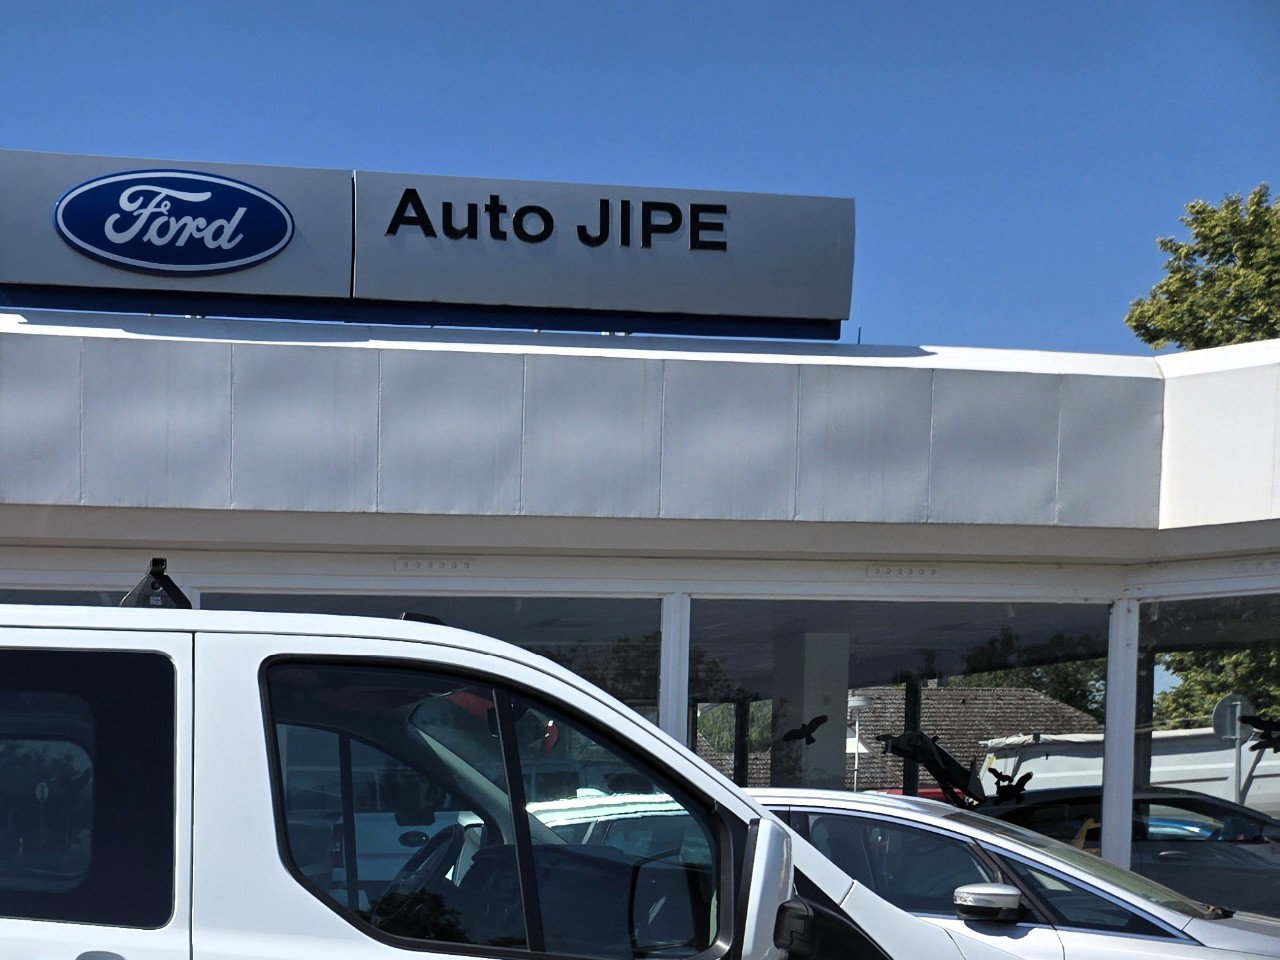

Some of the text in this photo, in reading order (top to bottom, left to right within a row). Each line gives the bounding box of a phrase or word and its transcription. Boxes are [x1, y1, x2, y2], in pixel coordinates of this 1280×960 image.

[104, 185, 247, 250] Ford
[384, 188, 727, 252] Auto JIPE
